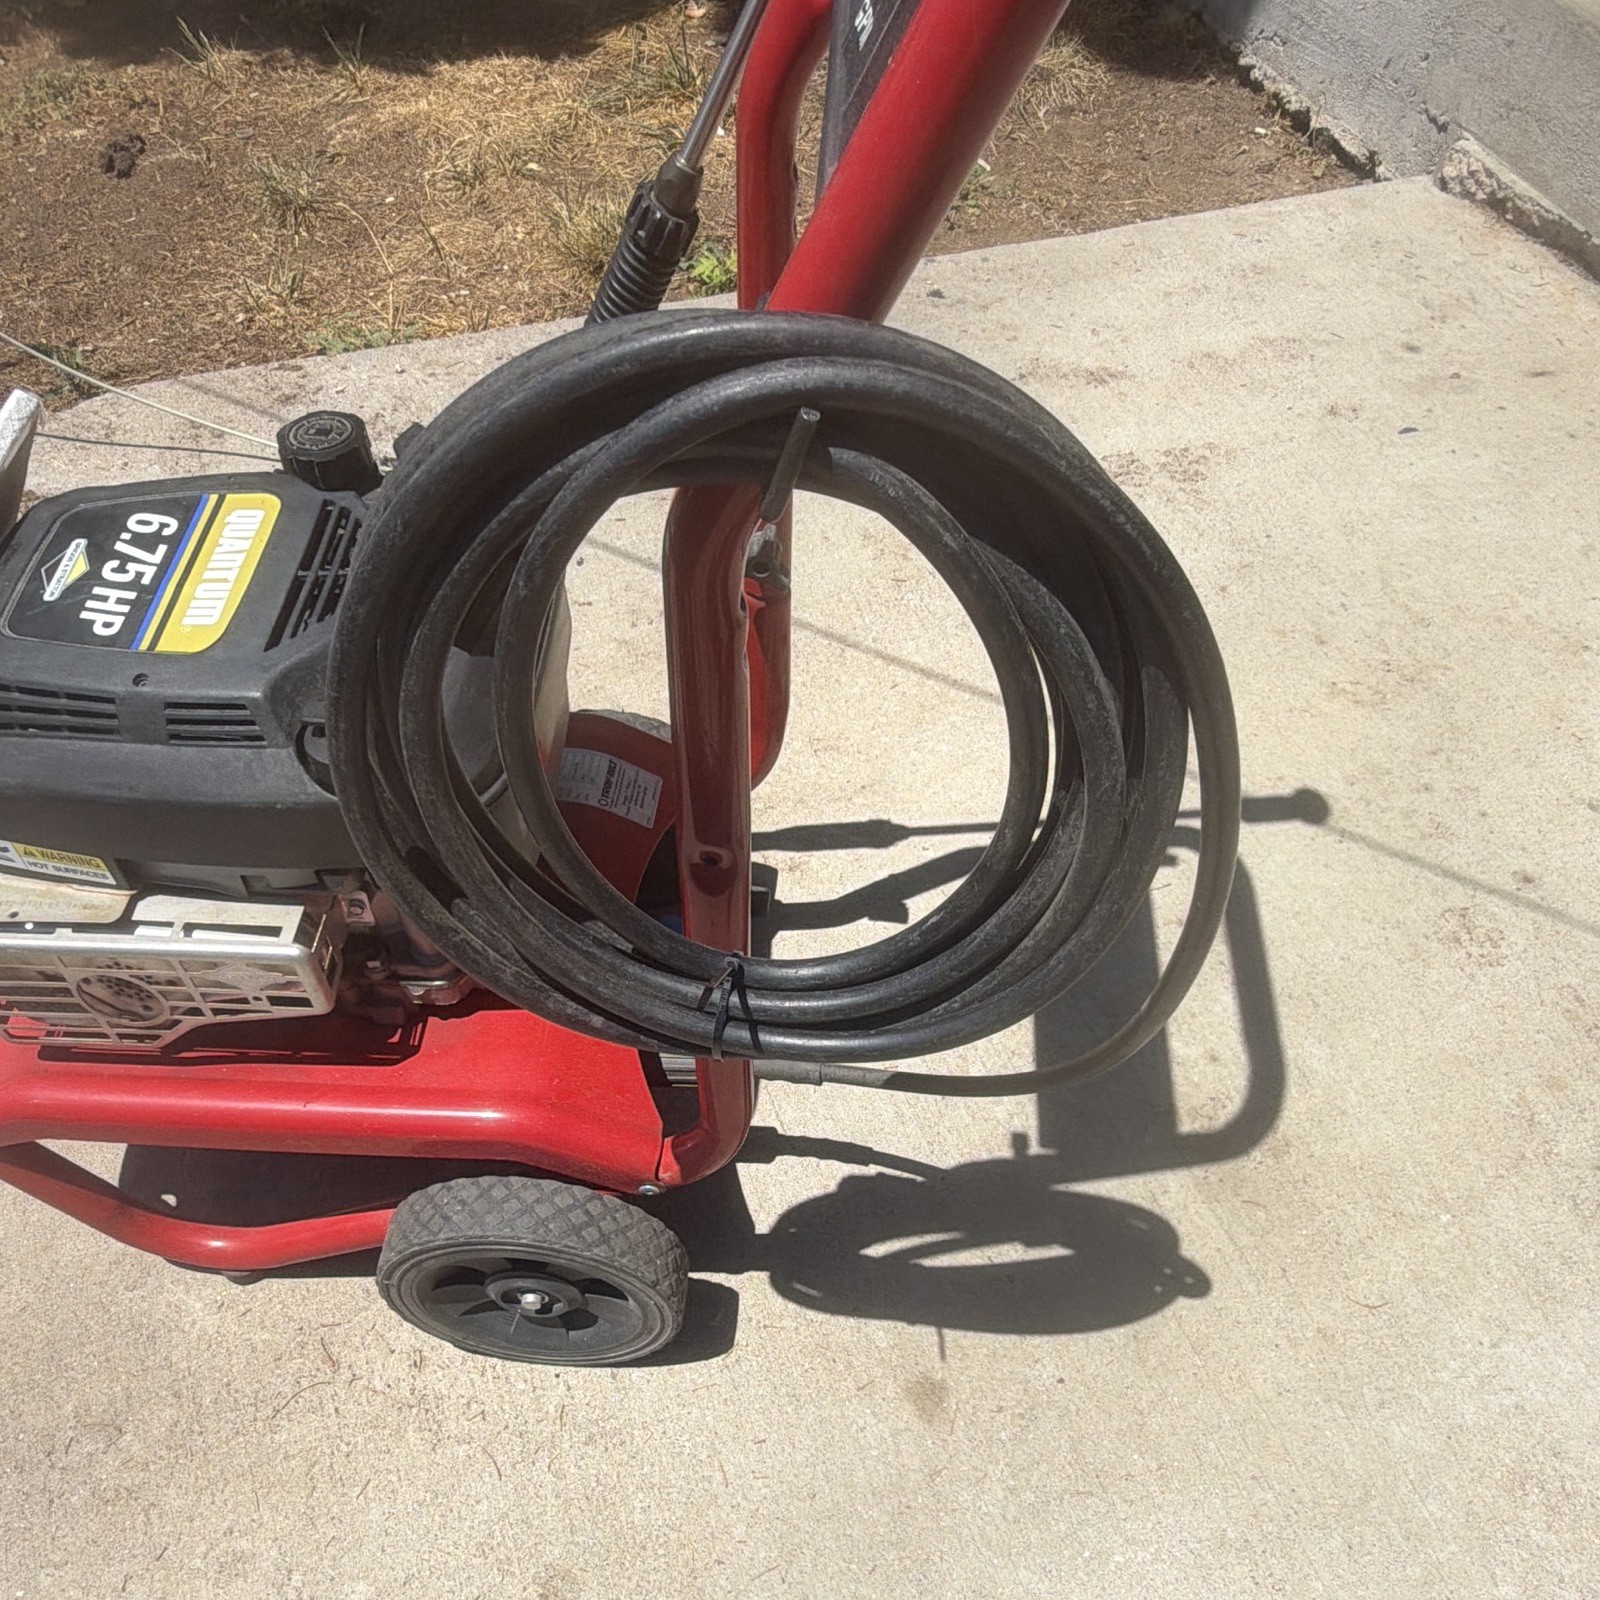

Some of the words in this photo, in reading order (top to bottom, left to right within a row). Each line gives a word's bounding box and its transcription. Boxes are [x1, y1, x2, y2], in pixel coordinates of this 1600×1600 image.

[101, 512, 179, 586] 6.75
[180, 509, 265, 626] QUANTUM
[79, 586, 138, 637] HP
[26, 860, 49, 870] HOT
[52, 864, 109, 881] SURFACES
[37, 848, 101, 869] WARNING
